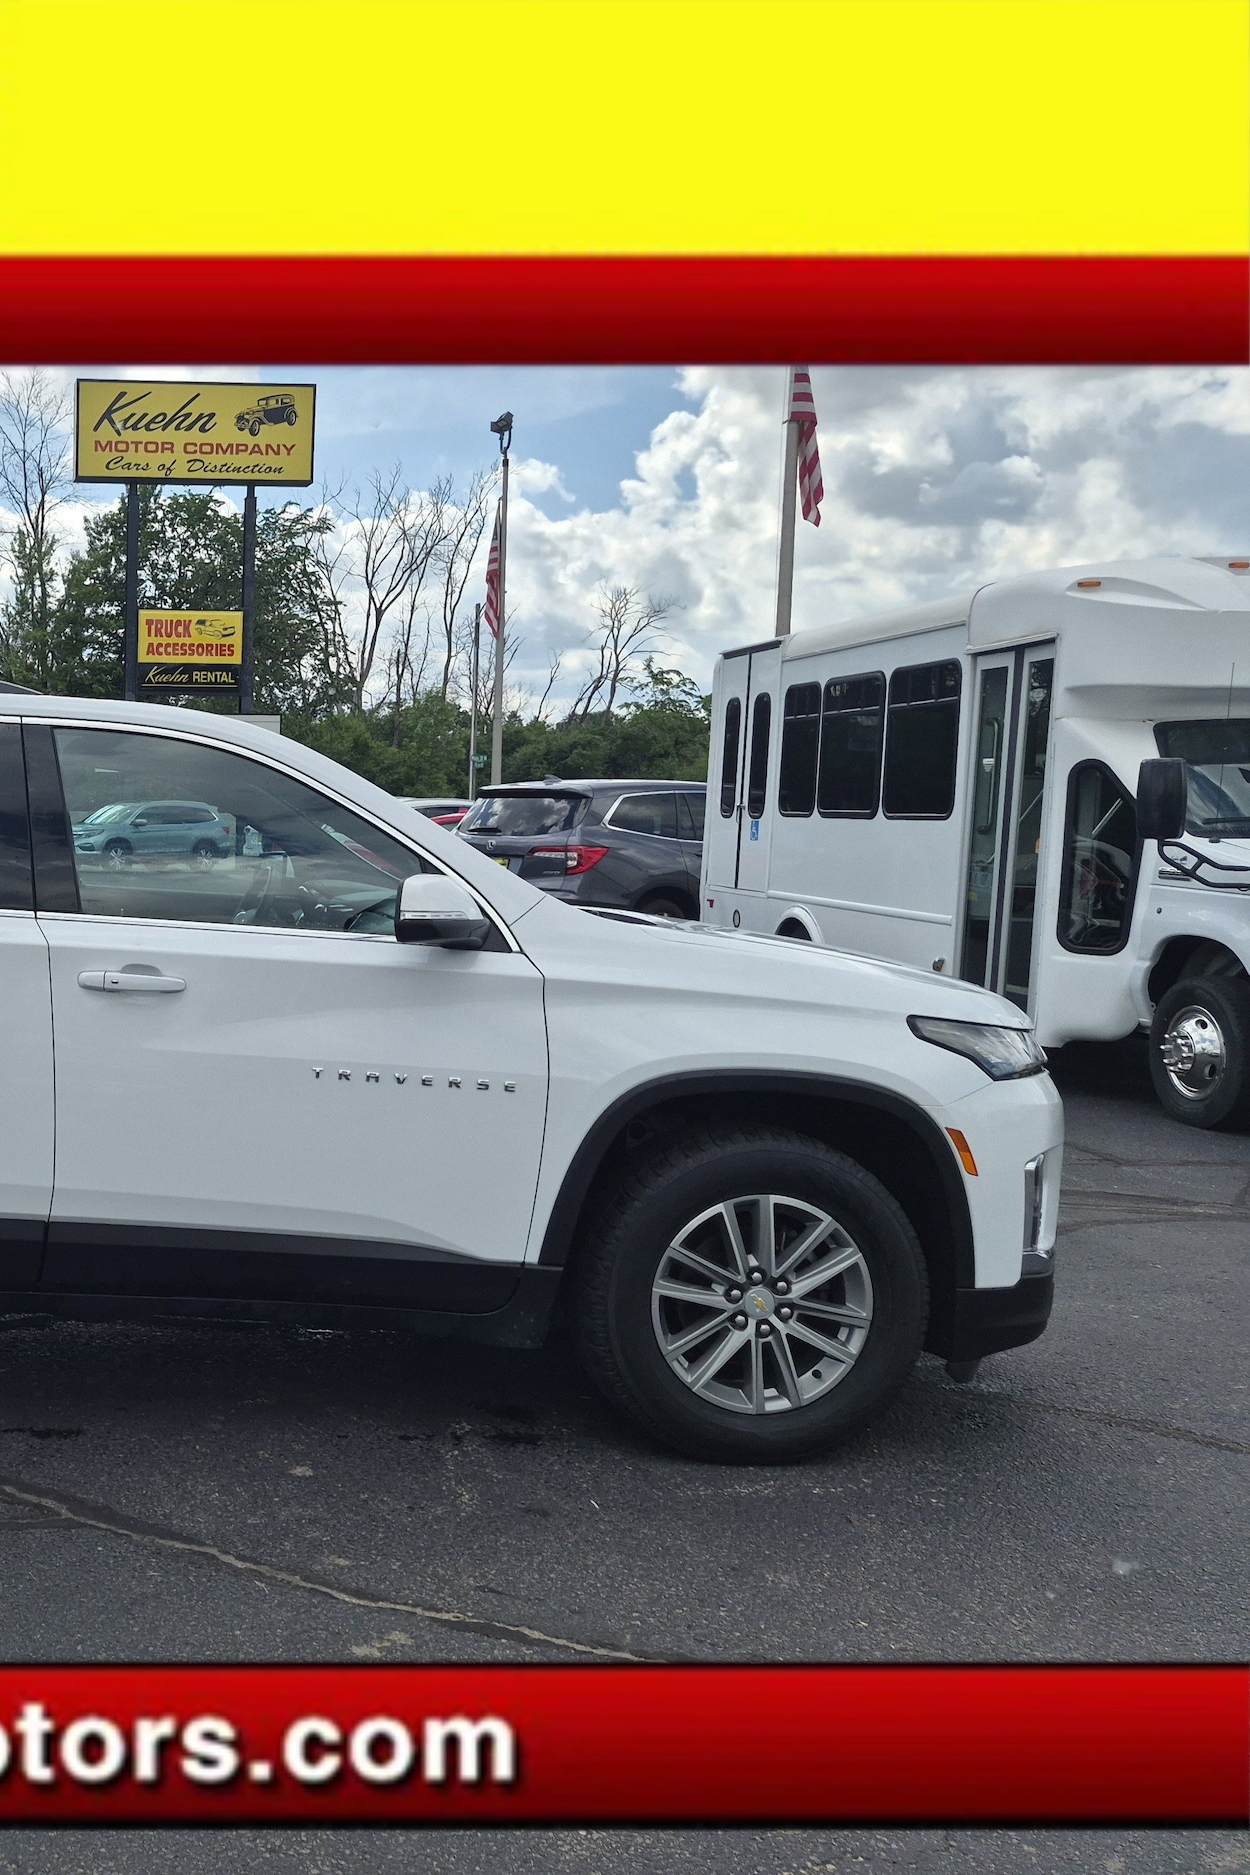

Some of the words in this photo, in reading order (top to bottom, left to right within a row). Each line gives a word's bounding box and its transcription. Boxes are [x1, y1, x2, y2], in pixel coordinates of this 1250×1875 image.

[92, 390, 218, 437] Kuehn
[94, 440, 175, 455] MOTOR
[183, 442, 297, 456] COMPANY
[105, 456, 152, 472] Cars
[157, 459, 178, 477] of
[186, 458, 285, 475] Distinction
[145, 618, 193, 639] TRUCK
[146, 642, 235, 657] ACCESSORIES
[144, 665, 190, 684] Kuehn
[192, 671, 236, 683] RENTAL
[311, 1066, 517, 1093] TRAVERSE
